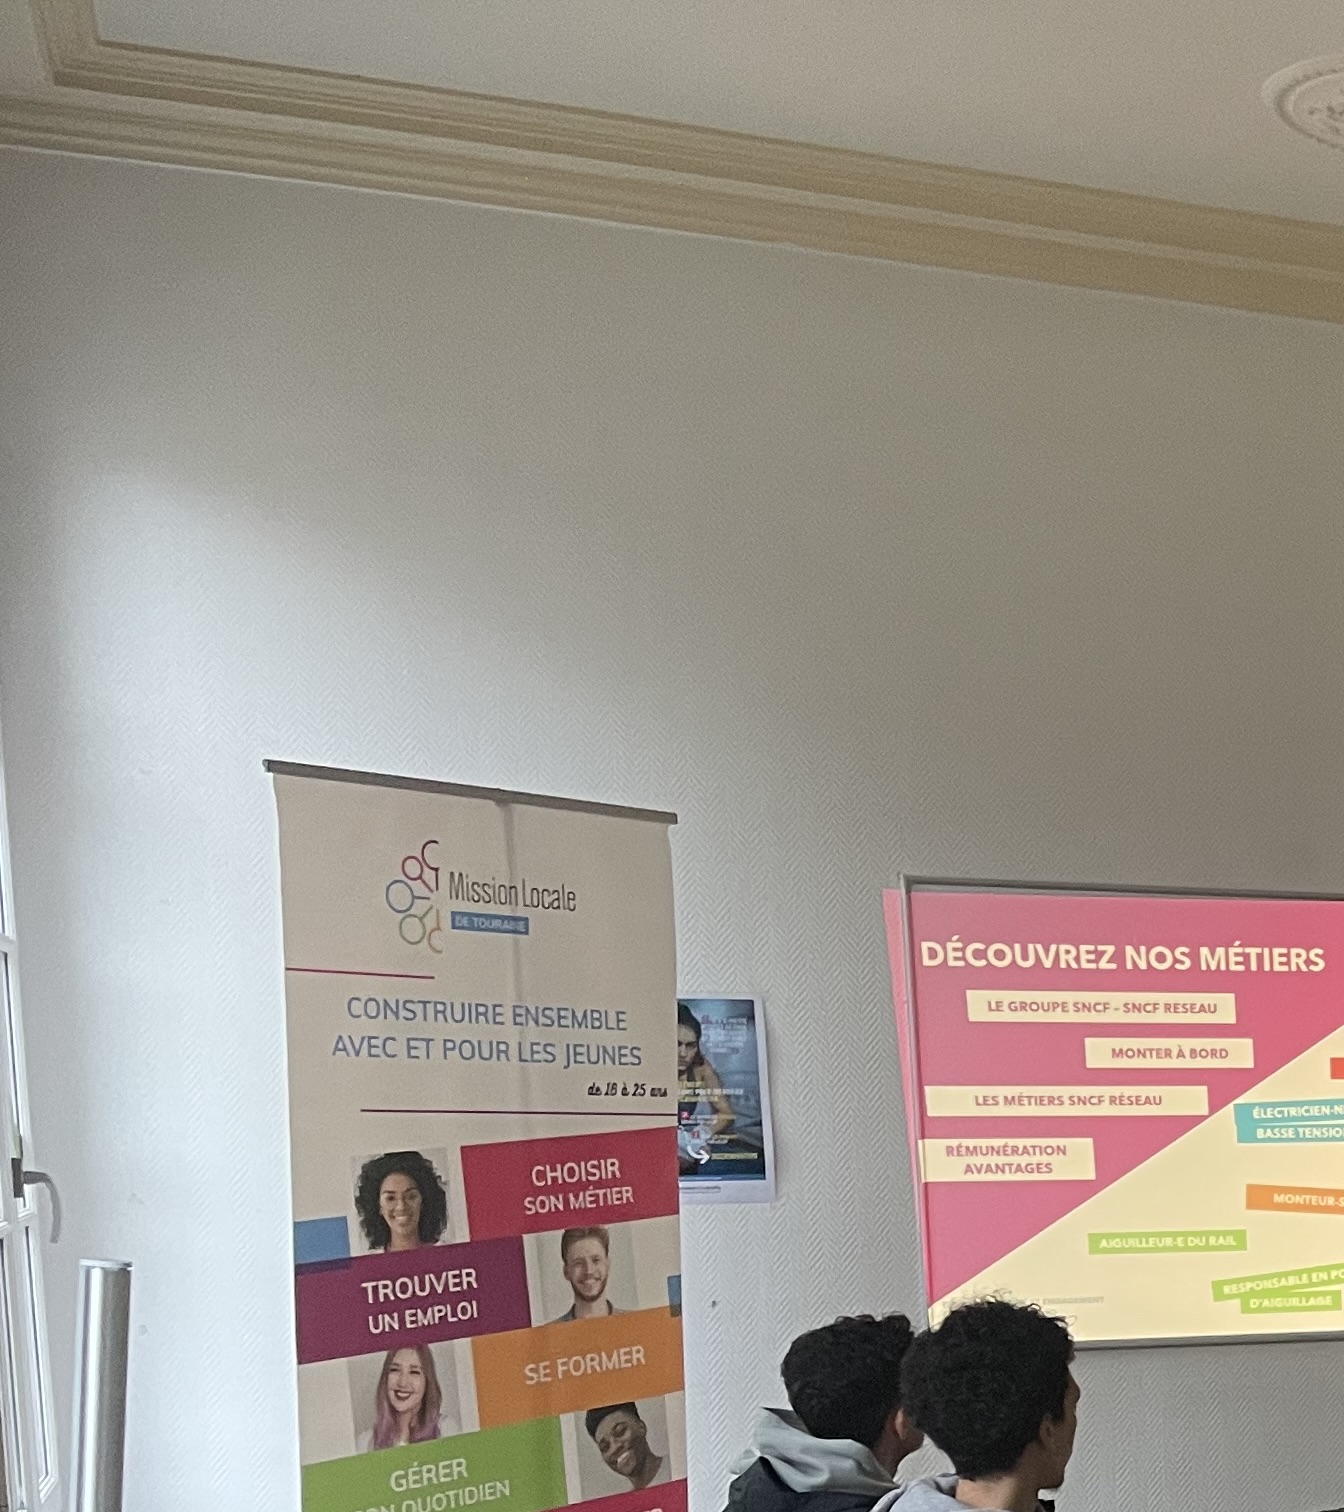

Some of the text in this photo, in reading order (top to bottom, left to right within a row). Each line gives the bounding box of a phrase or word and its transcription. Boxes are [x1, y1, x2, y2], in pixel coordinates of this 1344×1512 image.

[449, 871, 576, 911] Mission Locale
[920, 934, 1326, 972] DÉCOUVREZ NOS MÉTIERS
[347, 997, 628, 1031] CONSTRUIRE ENSEMBLE
[987, 1000, 1004, 1012] LE
[1007, 1001, 1069, 1013] GROUPE
[1072, 1001, 1110, 1014] SNCF
[1122, 1002, 1160, 1014] SNCF
[1163, 1002, 1218, 1014] RESEAU
[332, 1035, 642, 1069] AVEC ET POUR LES JEUNES
[1111, 1043, 1229, 1060] MONTER À BORD
[587, 1082, 602, 1096] de
[621, 1082, 630, 1096] à
[632, 1083, 646, 1096] 25
[974, 1091, 1162, 1106] LES MÉTIERS SNCF RÉSEAU
[1256, 1127, 1295, 1139] BASSE
[946, 1141, 1067, 1157] RÉMUNÉRATION
[531, 1158, 620, 1187] CHOISIR
[963, 1162, 1053, 1175] AVANTAGES
[523, 1184, 634, 1215] SON MÉTIER
[1099, 1235, 1237, 1249] AIGUILLEUR-E DU RAIL
[362, 1268, 478, 1303] TROUVER
[1223, 1273, 1310, 1295] RESPONSABLE
[1311, 1271, 1329, 1283] EN
[368, 1300, 478, 1334] UN EMPLOI
[524, 1345, 645, 1385] SE FORMER
[390, 1458, 468, 1493] GÉRER
